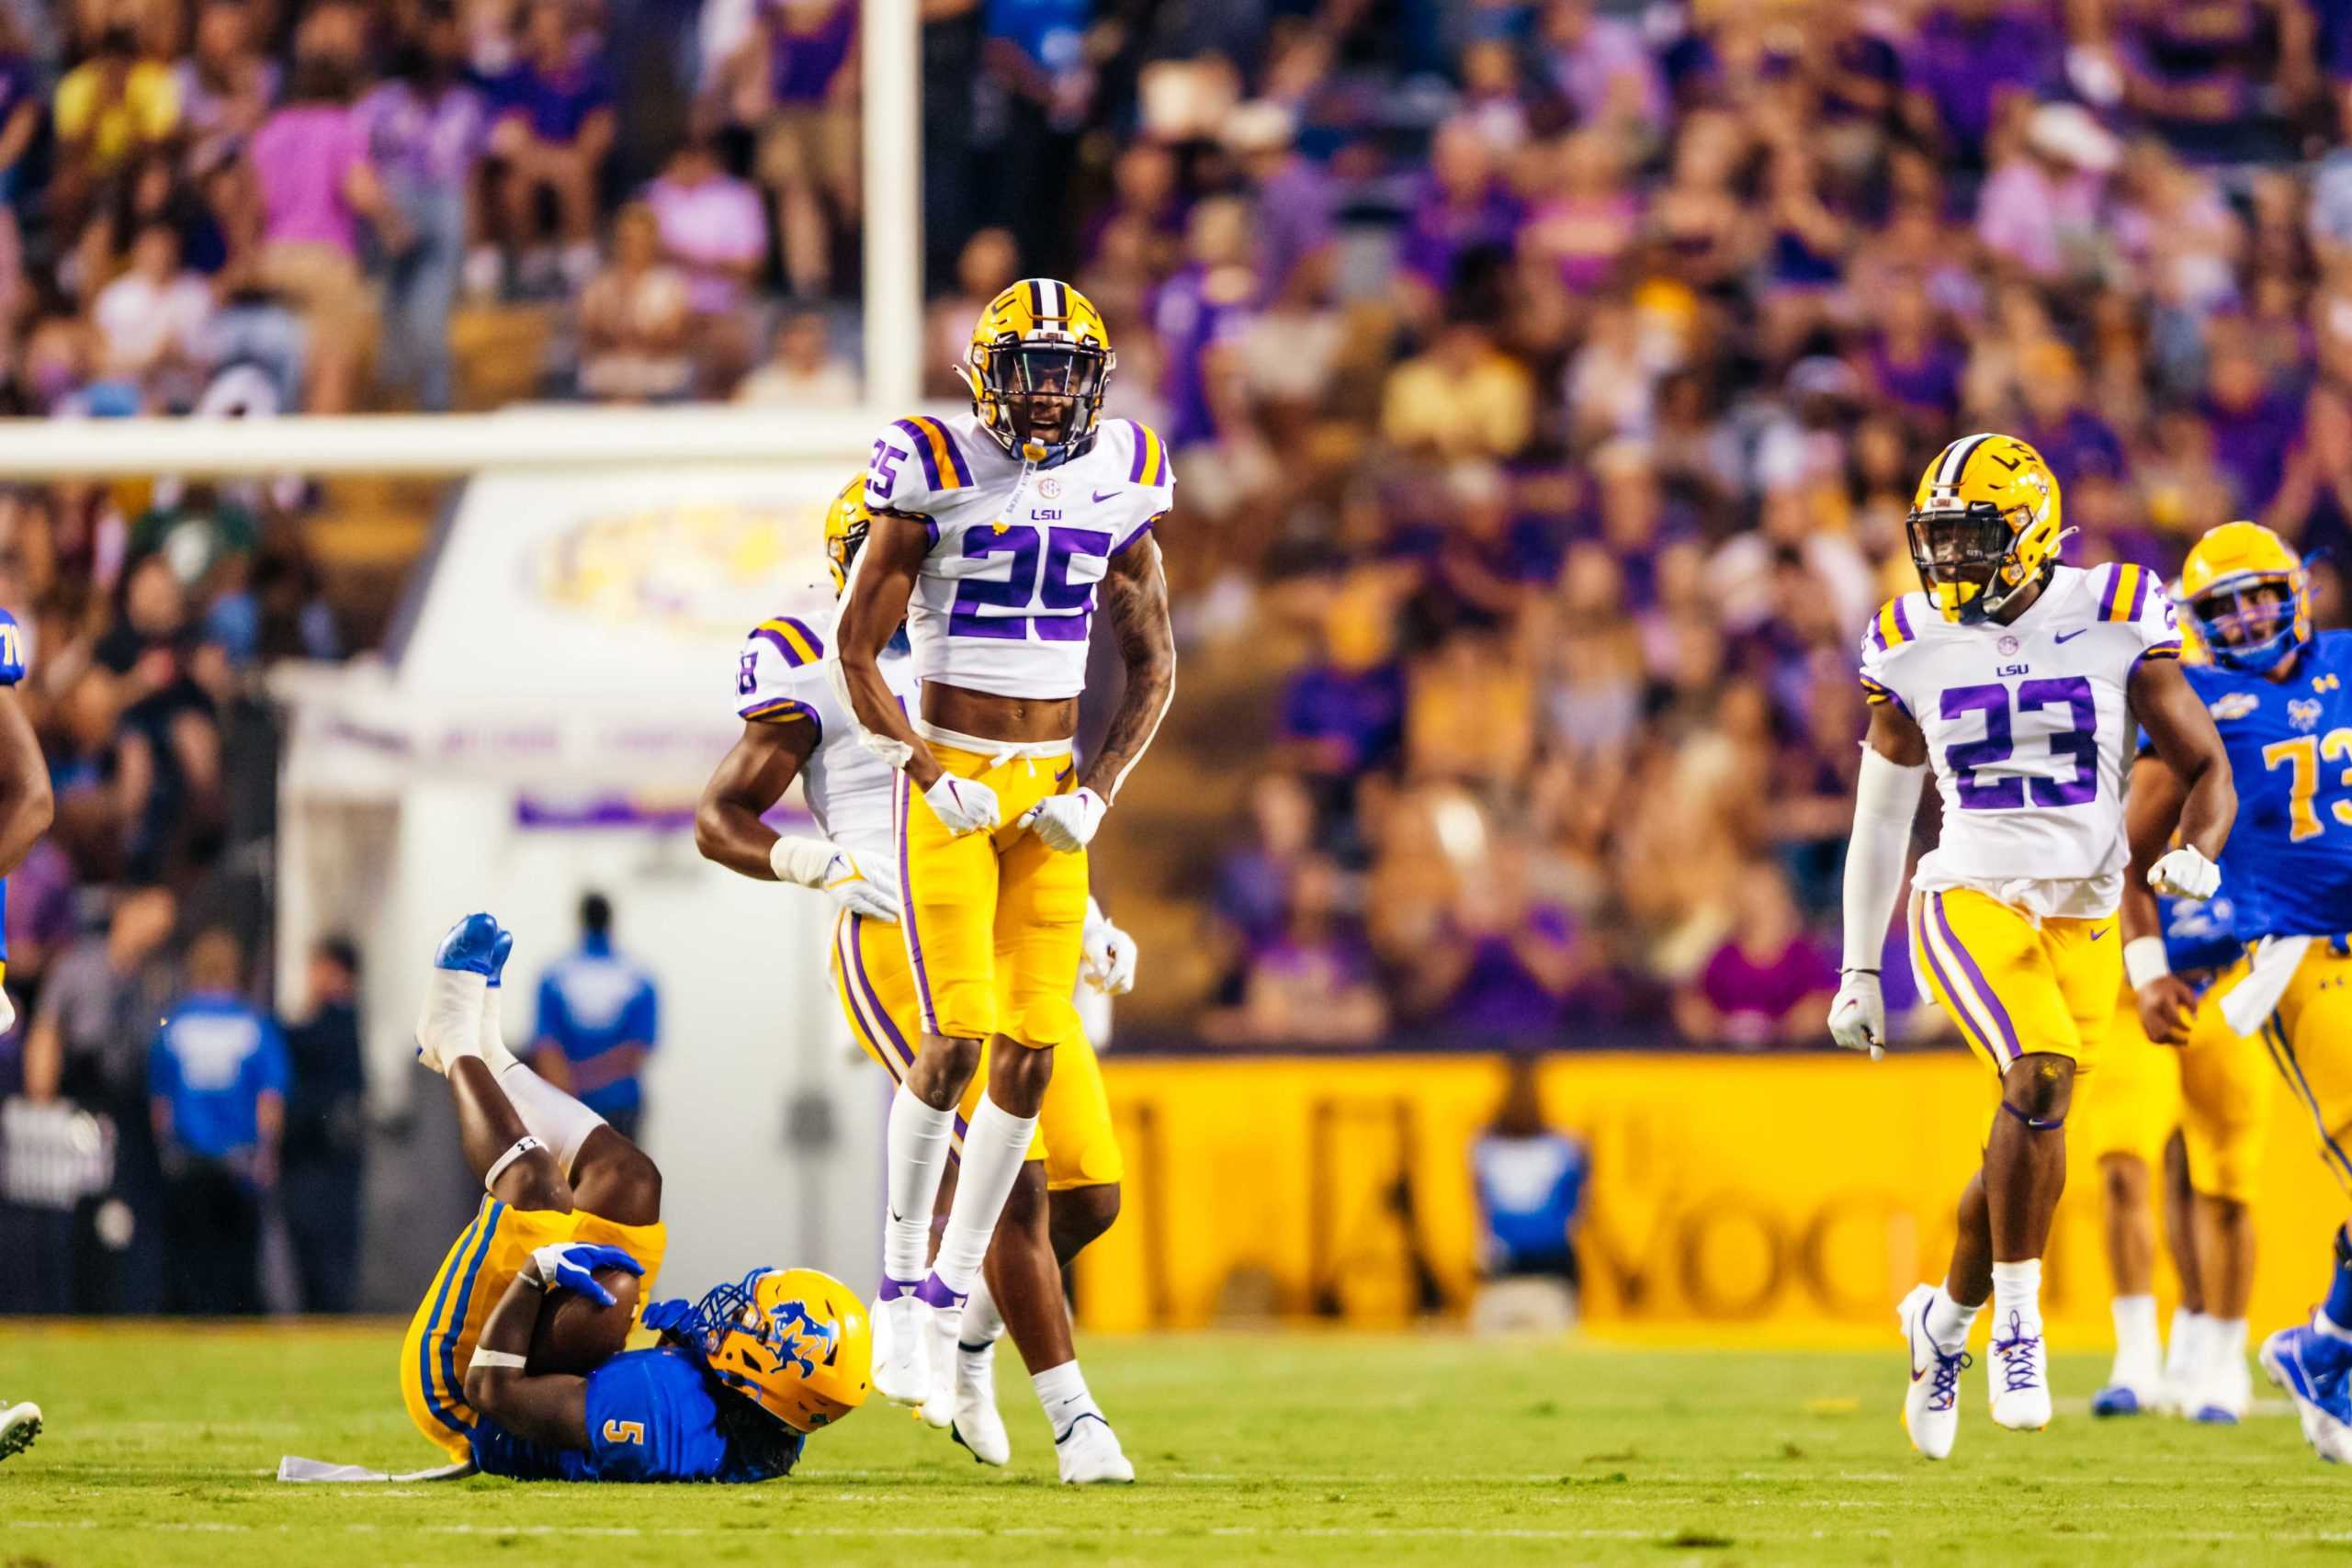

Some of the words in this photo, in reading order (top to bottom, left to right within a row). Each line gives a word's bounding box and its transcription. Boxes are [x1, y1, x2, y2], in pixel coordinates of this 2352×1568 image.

[1031, 509, 1062, 521] LSU
[948, 525, 1113, 642] 25
[736, 650, 759, 695] 8
[1996, 663, 2030, 677] LSU
[1939, 675, 2098, 809] 23
[2261, 726, 2352, 844] 73
[602, 1418, 645, 1446] 5
